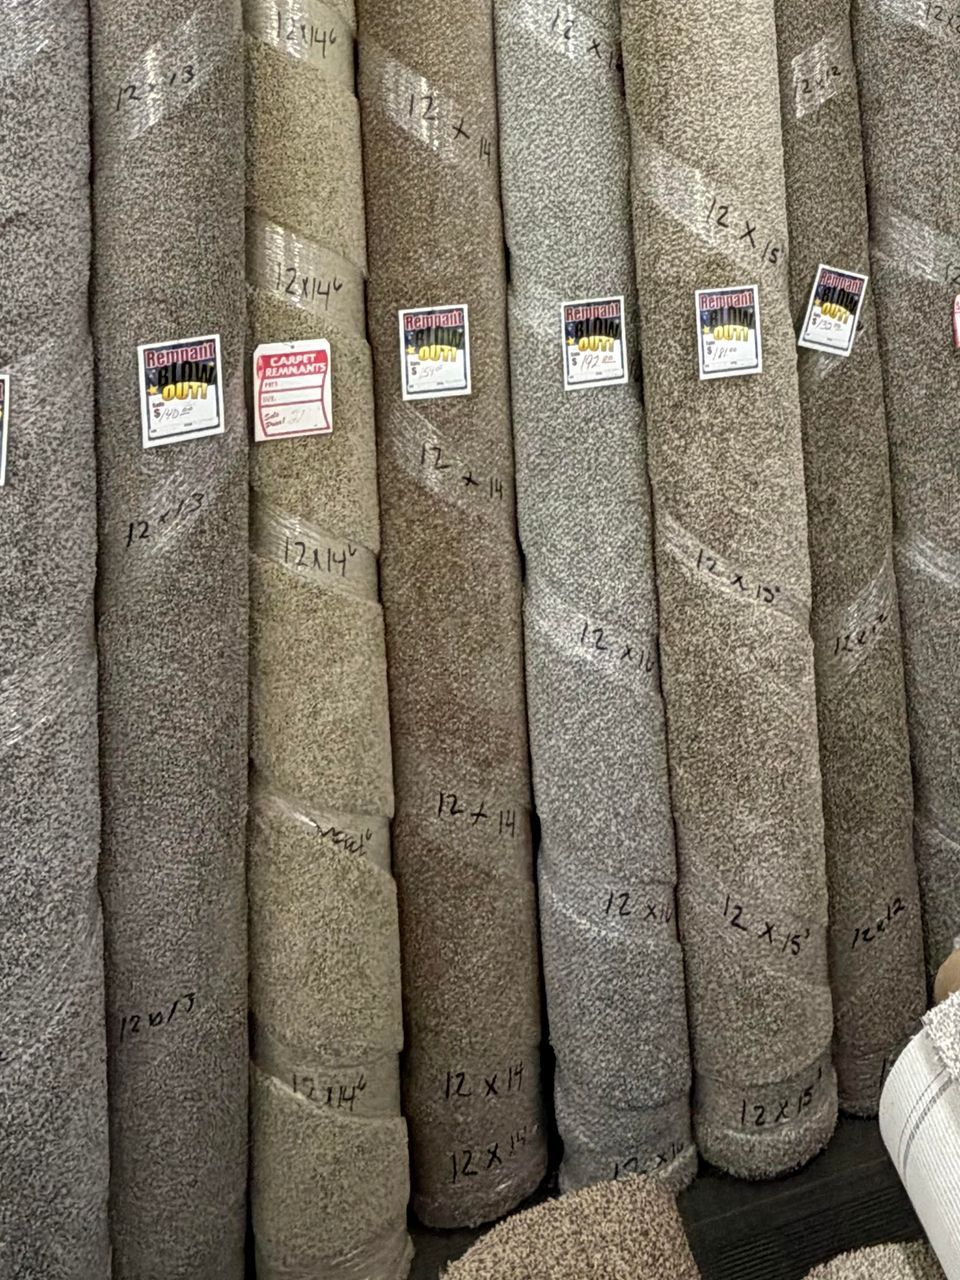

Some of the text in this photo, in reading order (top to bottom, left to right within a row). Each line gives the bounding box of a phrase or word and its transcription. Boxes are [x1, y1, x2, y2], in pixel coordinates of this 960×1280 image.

[587, 38, 602, 60] x
[116, 84, 142, 111] 12
[408, 93, 493, 170] 12 x 14
[704, 196, 757, 249] 12 x
[819, 271, 862, 295] Remnant
[566, 302, 620, 322] Remnant
[700, 291, 753, 310] Remnant
[404, 311, 463, 330] Remnant
[820, 302, 851, 325] OUT!
[575, 317, 620, 338] BLOW
[713, 324, 749, 342] OUT!
[146, 342, 214, 368] Remnant
[417, 344, 458, 362] OUT!
[577, 336, 615, 352] OUT!
[706, 345, 713, 356] $
[265, 363, 327, 377] REMNANTS
[269, 353, 317, 366] CARPET
[571, 357, 578, 367] $
[158, 361, 214, 387] BLOW
[161, 381, 208, 401] OUT!
[153, 408, 161, 419] $
[420, 441, 505, 500] 12 x 14
[126, 520, 150, 548] 12
[580, 622, 635, 661] 12 x
[436, 790, 518, 839] 12 x 14
[603, 891, 659, 920] 12 x
[722, 894, 748, 932] 12
[757, 920, 776, 945] x
[119, 991, 198, 1043] 12 13
[444, 1060, 527, 1100] 12 x 14
[739, 1099, 791, 1127] 12 x
[450, 1142, 504, 1184] 12 x
